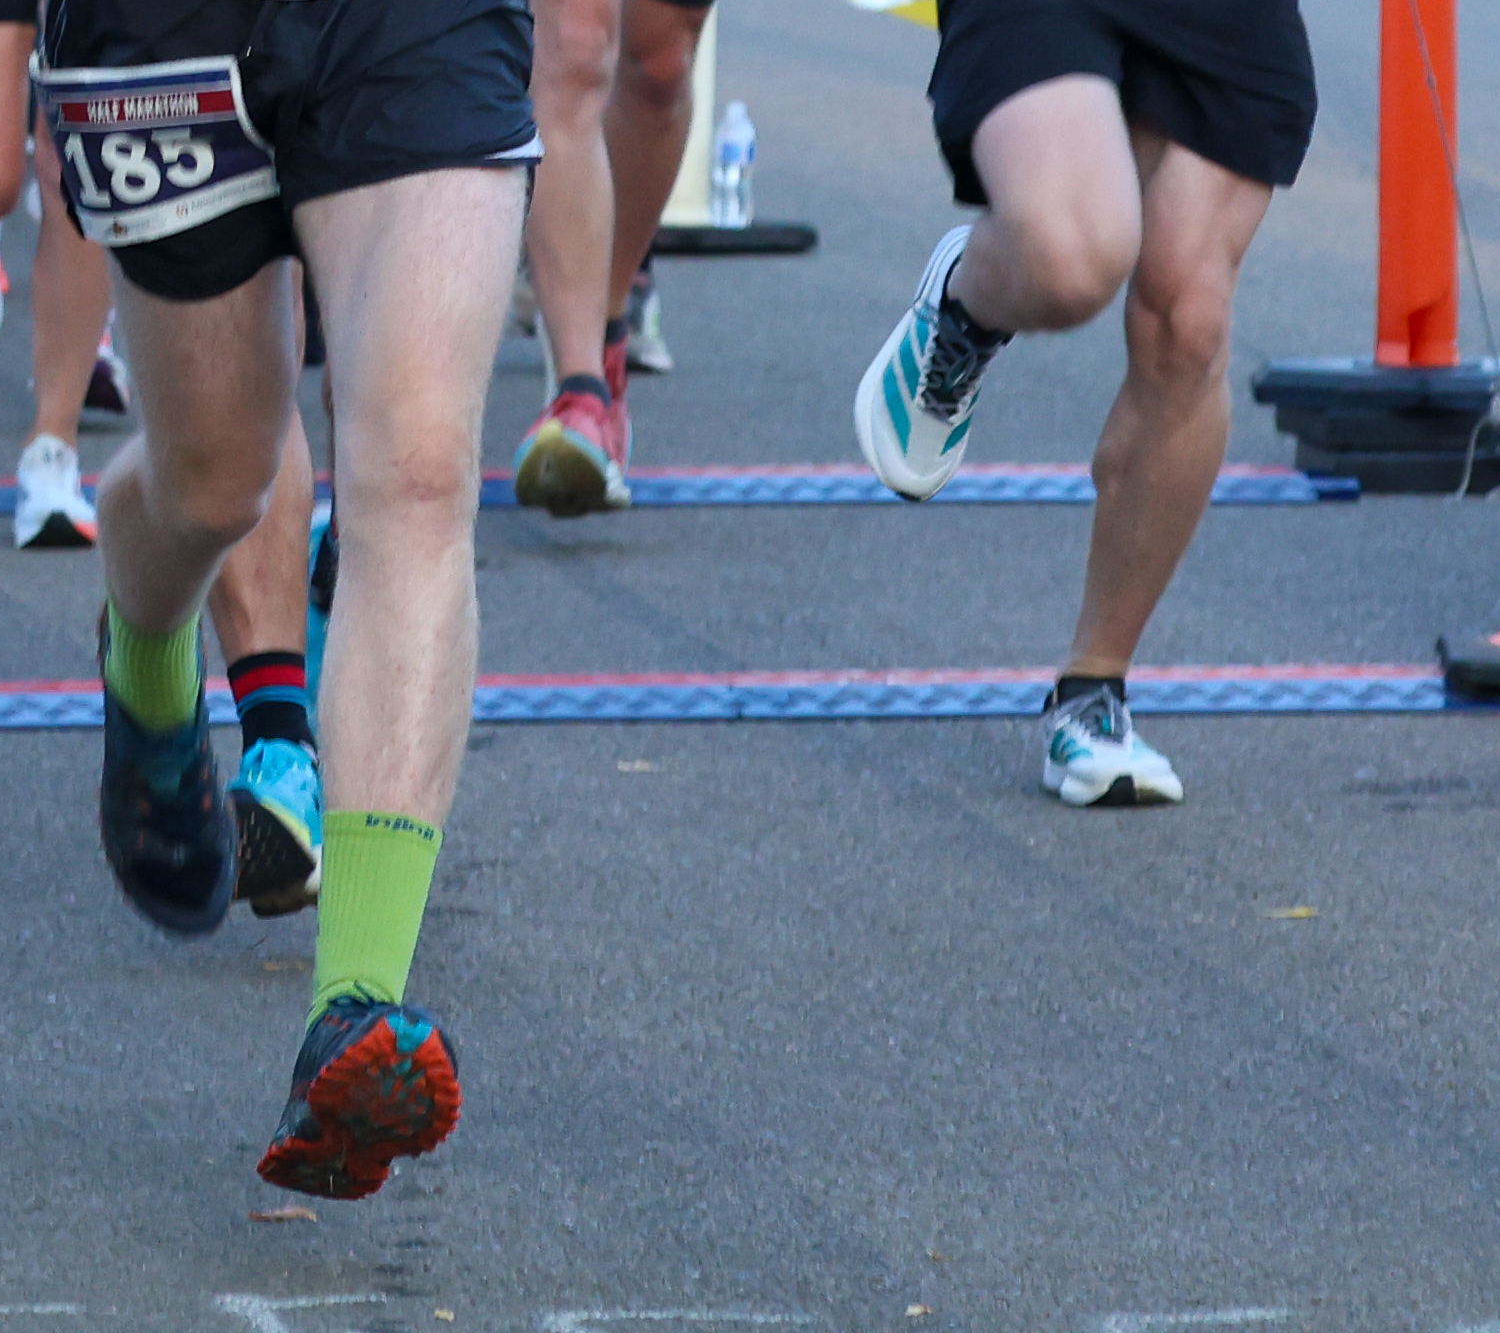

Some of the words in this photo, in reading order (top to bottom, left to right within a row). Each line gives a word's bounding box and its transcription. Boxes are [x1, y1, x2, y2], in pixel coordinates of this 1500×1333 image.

[86, 98, 120, 124] HALF
[123, 90, 199, 121] MARATHON
[64, 126, 216, 209] 185
